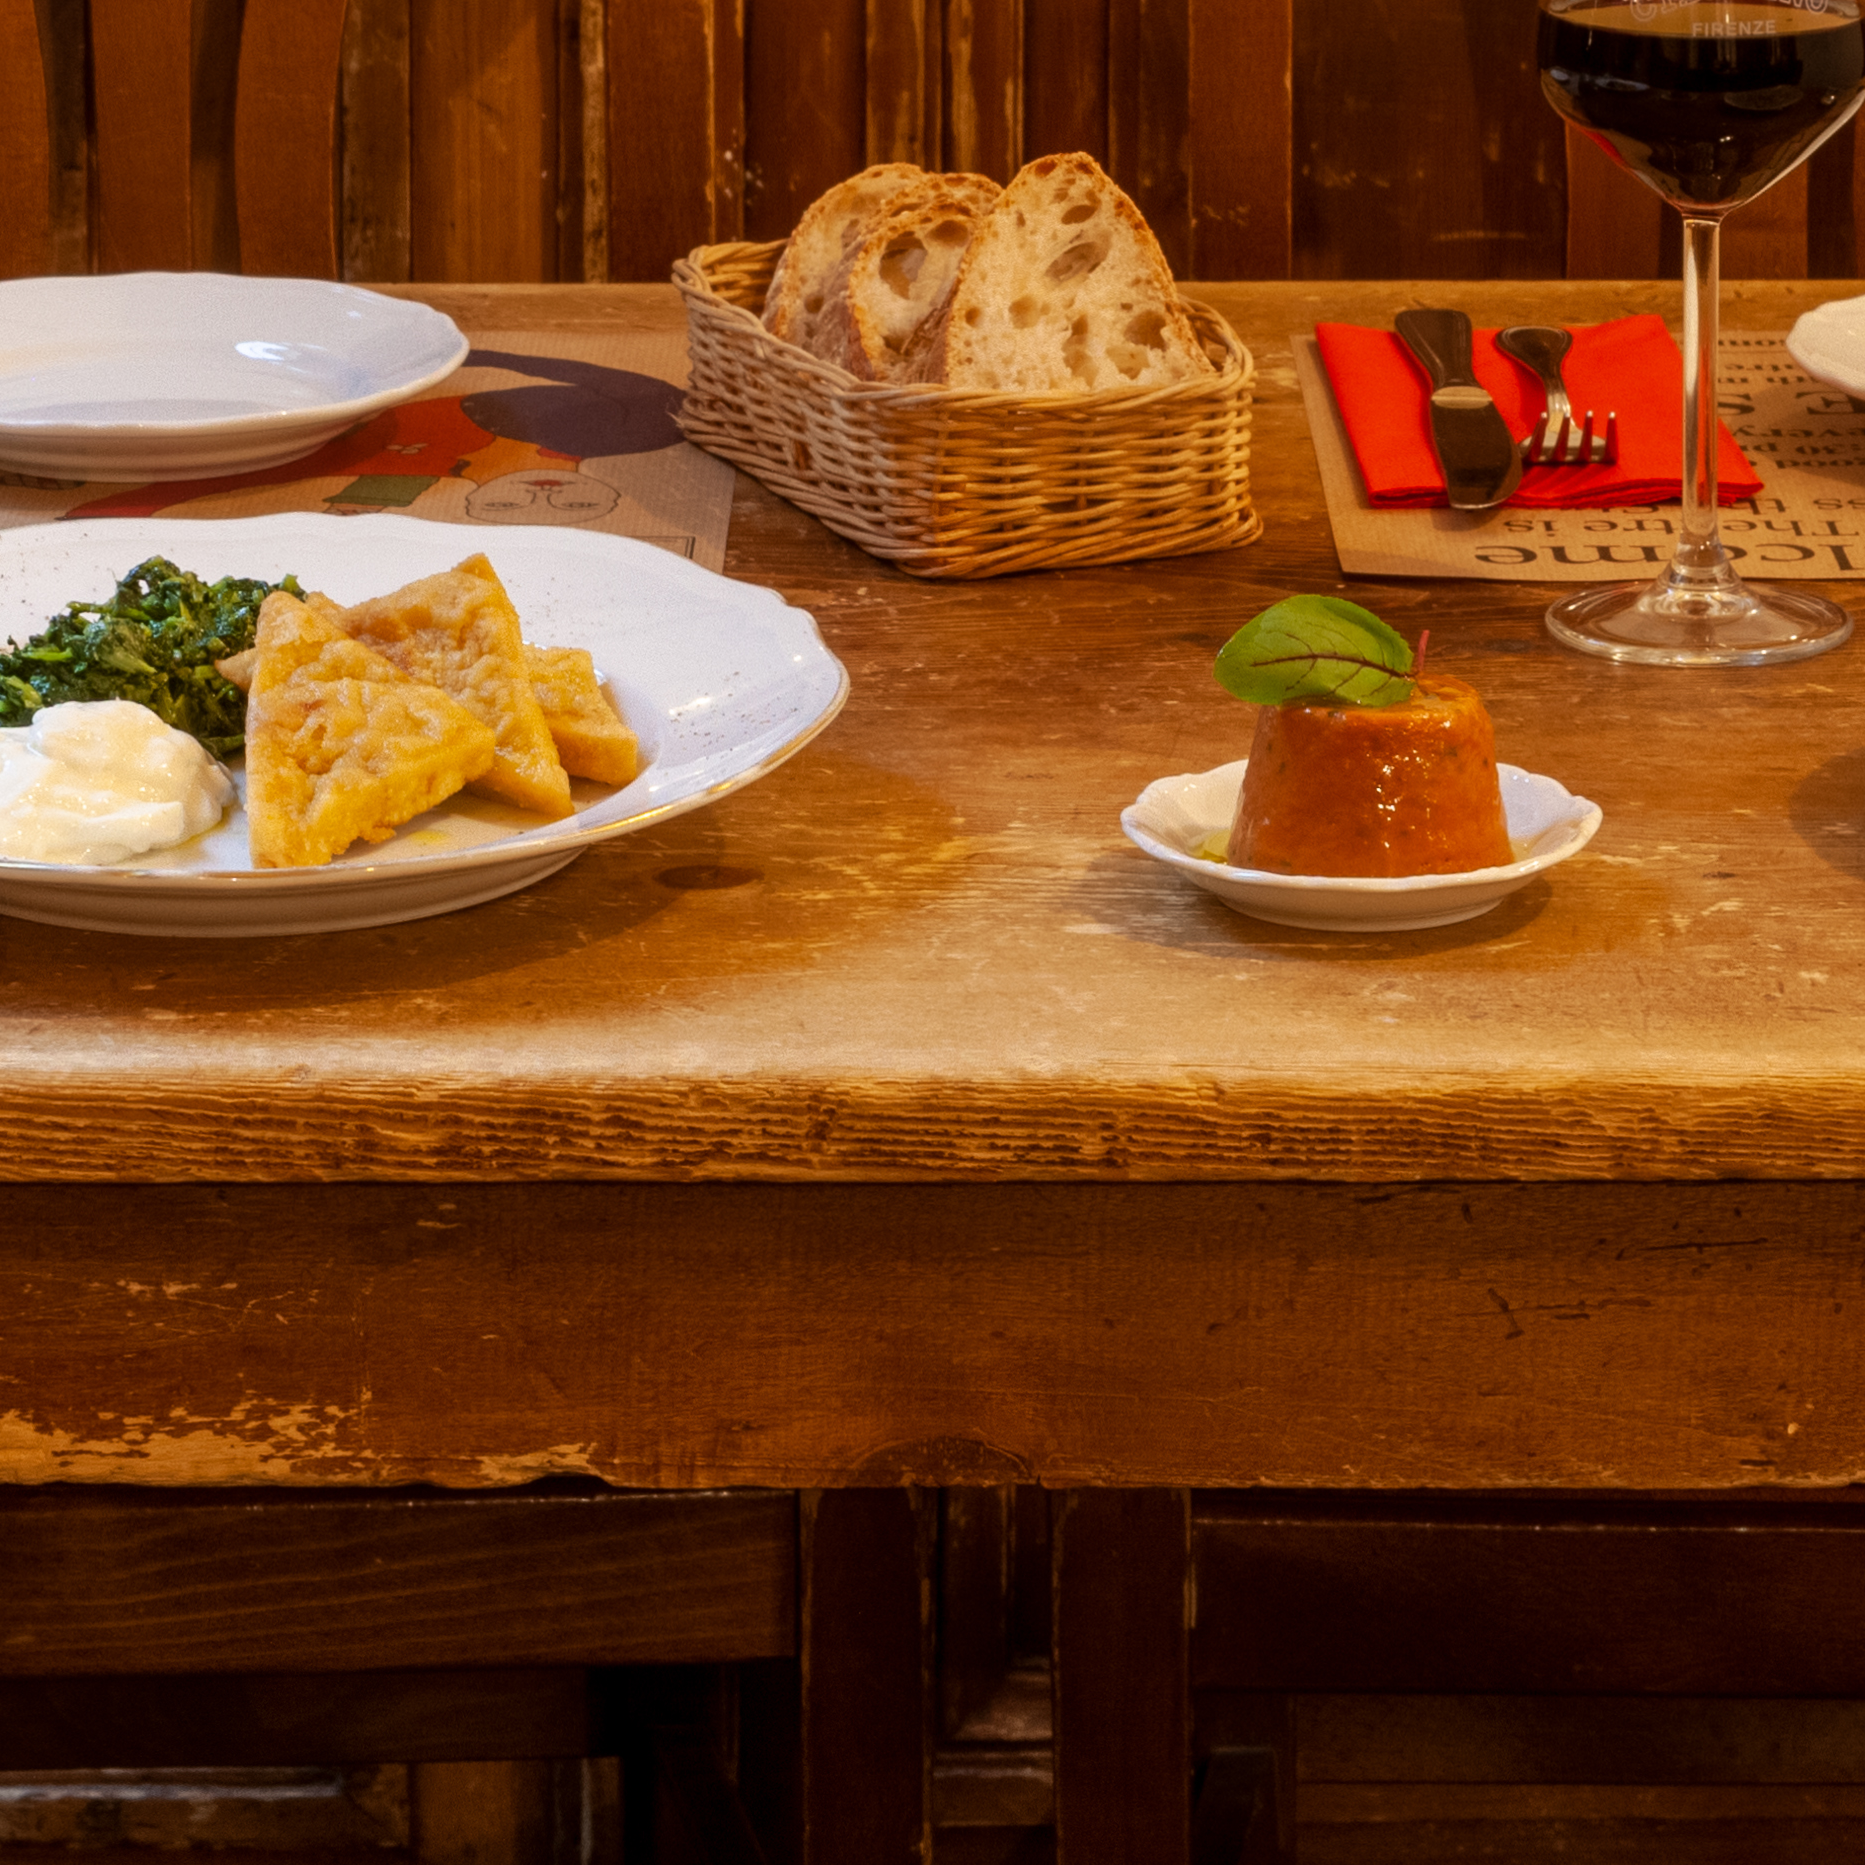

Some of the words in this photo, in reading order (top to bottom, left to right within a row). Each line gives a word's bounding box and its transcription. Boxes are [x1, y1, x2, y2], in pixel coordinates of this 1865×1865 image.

[1691, 18, 1778, 39] FIRENZE
[1502, 519, 1558, 538] is
[1582, 517, 1860, 538] Thetre
